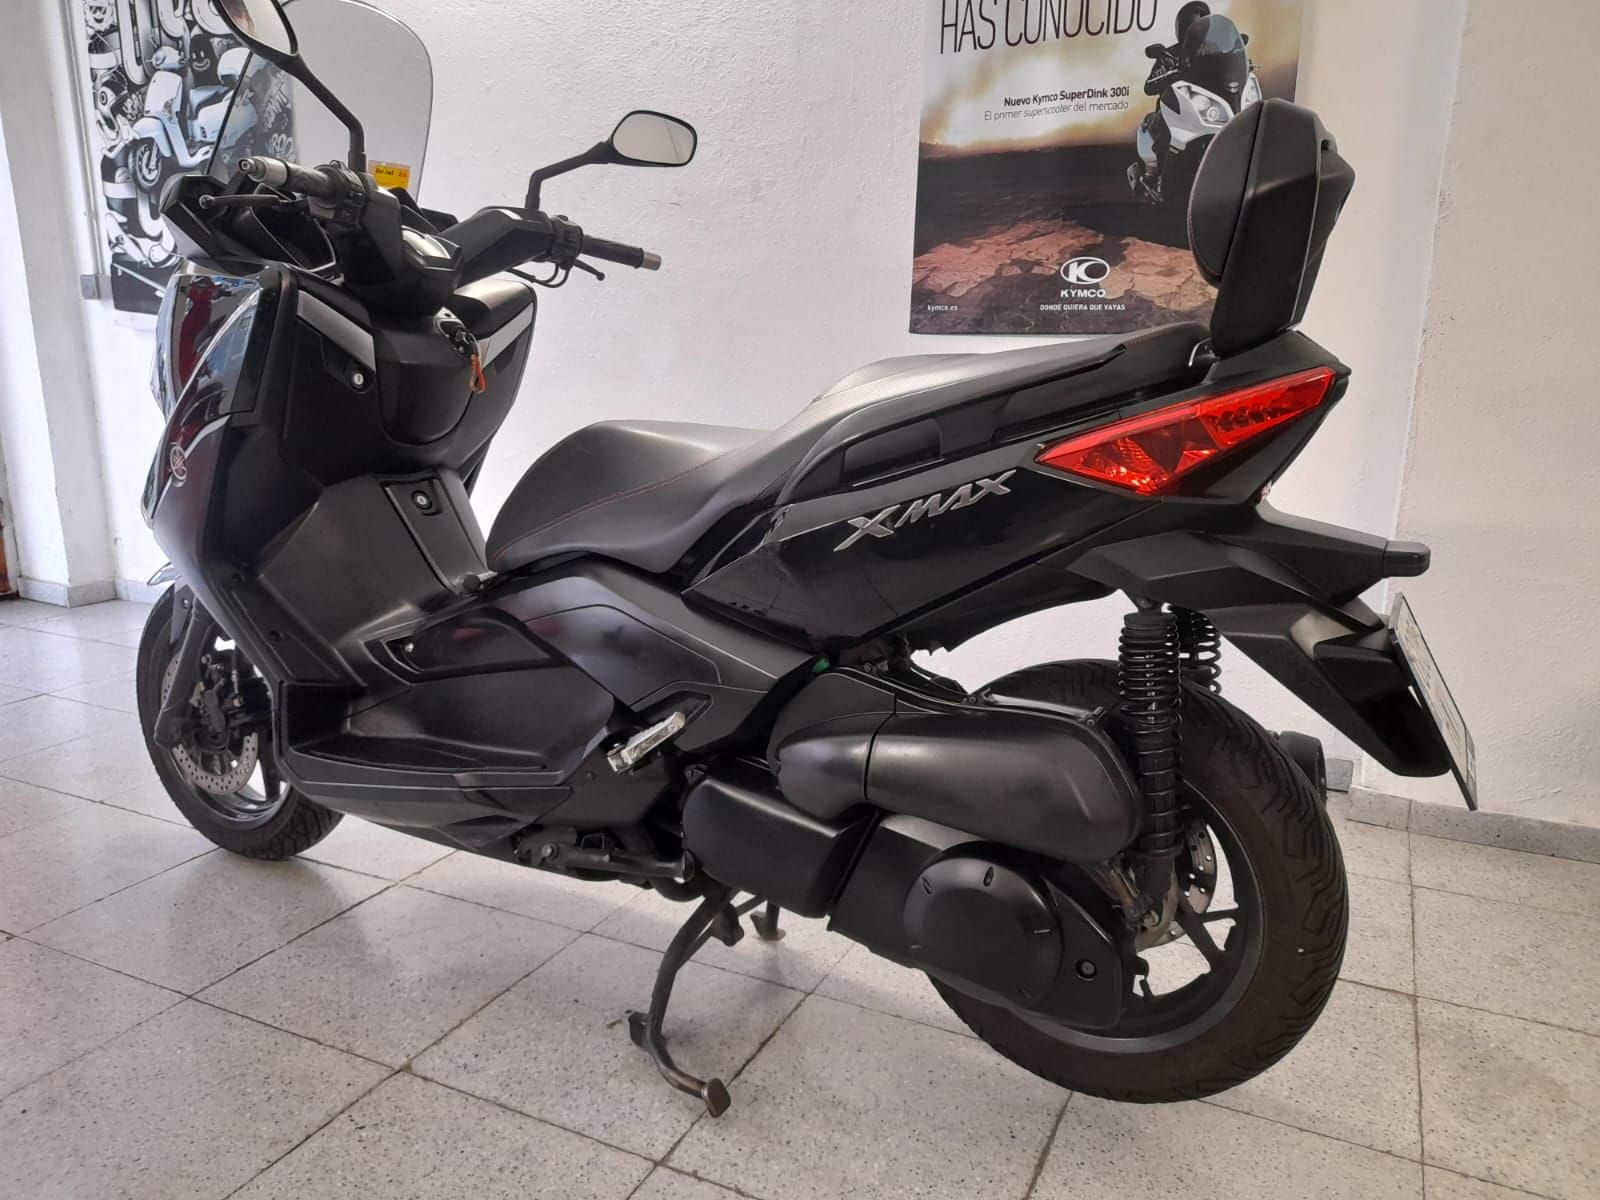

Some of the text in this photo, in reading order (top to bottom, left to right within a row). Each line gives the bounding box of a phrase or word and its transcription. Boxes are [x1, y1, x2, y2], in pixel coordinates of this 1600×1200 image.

[940, 0, 1158, 54] HAS CONOCIDO
[1003, 86, 1130, 107] Nuevo Kymco SuperDink 300i
[984, 110, 992, 121] El
[993, 109, 1022, 121] primer
[1072, 101, 1087, 112] del
[1088, 100, 1129, 112] mercado
[1060, 288, 1106, 298] KYMCO
[1040, 303, 1126, 311] DONDE QUIERA QUE VAYAS
